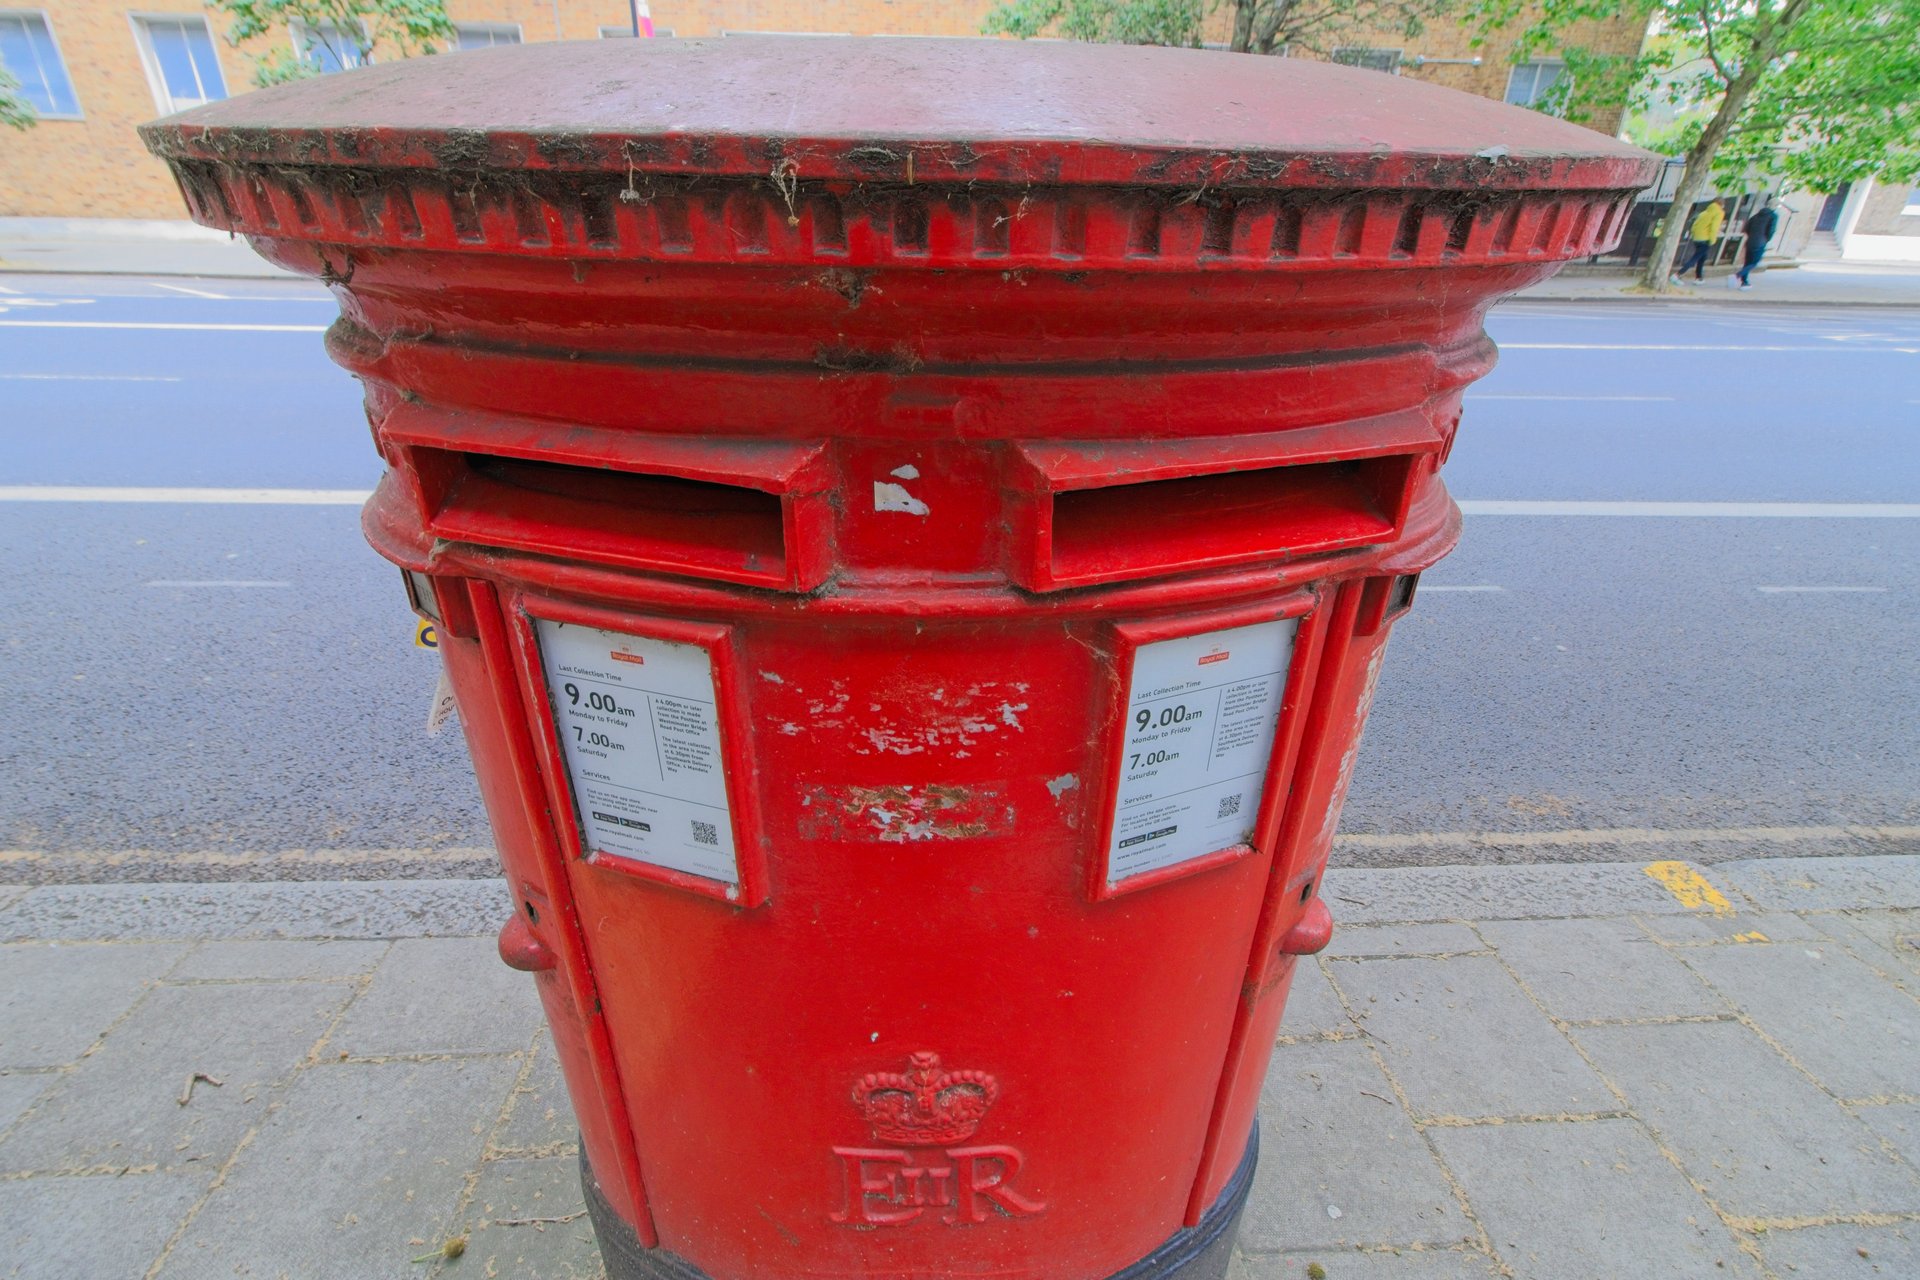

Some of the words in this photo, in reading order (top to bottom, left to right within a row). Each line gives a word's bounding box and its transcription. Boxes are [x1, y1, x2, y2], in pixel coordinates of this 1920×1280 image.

[1200, 655, 1215, 665] Royal
[1215, 652, 1228, 660] Mail
[558, 664, 573, 673] Last
[573, 666, 604, 678] Collection
[605, 672, 622, 681] Time
[1137, 689, 1152, 700] Last
[1153, 684, 1184, 696] Collection
[1185, 680, 1202, 689] Time
[564, 683, 635, 717] 9.00am
[568, 709, 595, 721] Monday
[606, 717, 628, 728] Friday
[1135, 704, 1203, 733] 9.00am
[572, 726, 625, 750] 7.00am
[1131, 733, 1160, 745] Monday
[1170, 725, 1192, 736] Friday
[577, 746, 607, 759] Saturday
[1129, 749, 1180, 770] 7.00am
[582, 769, 610, 780] Services
[1127, 769, 1158, 782] Saturday
[1124, 793, 1153, 805] Services
